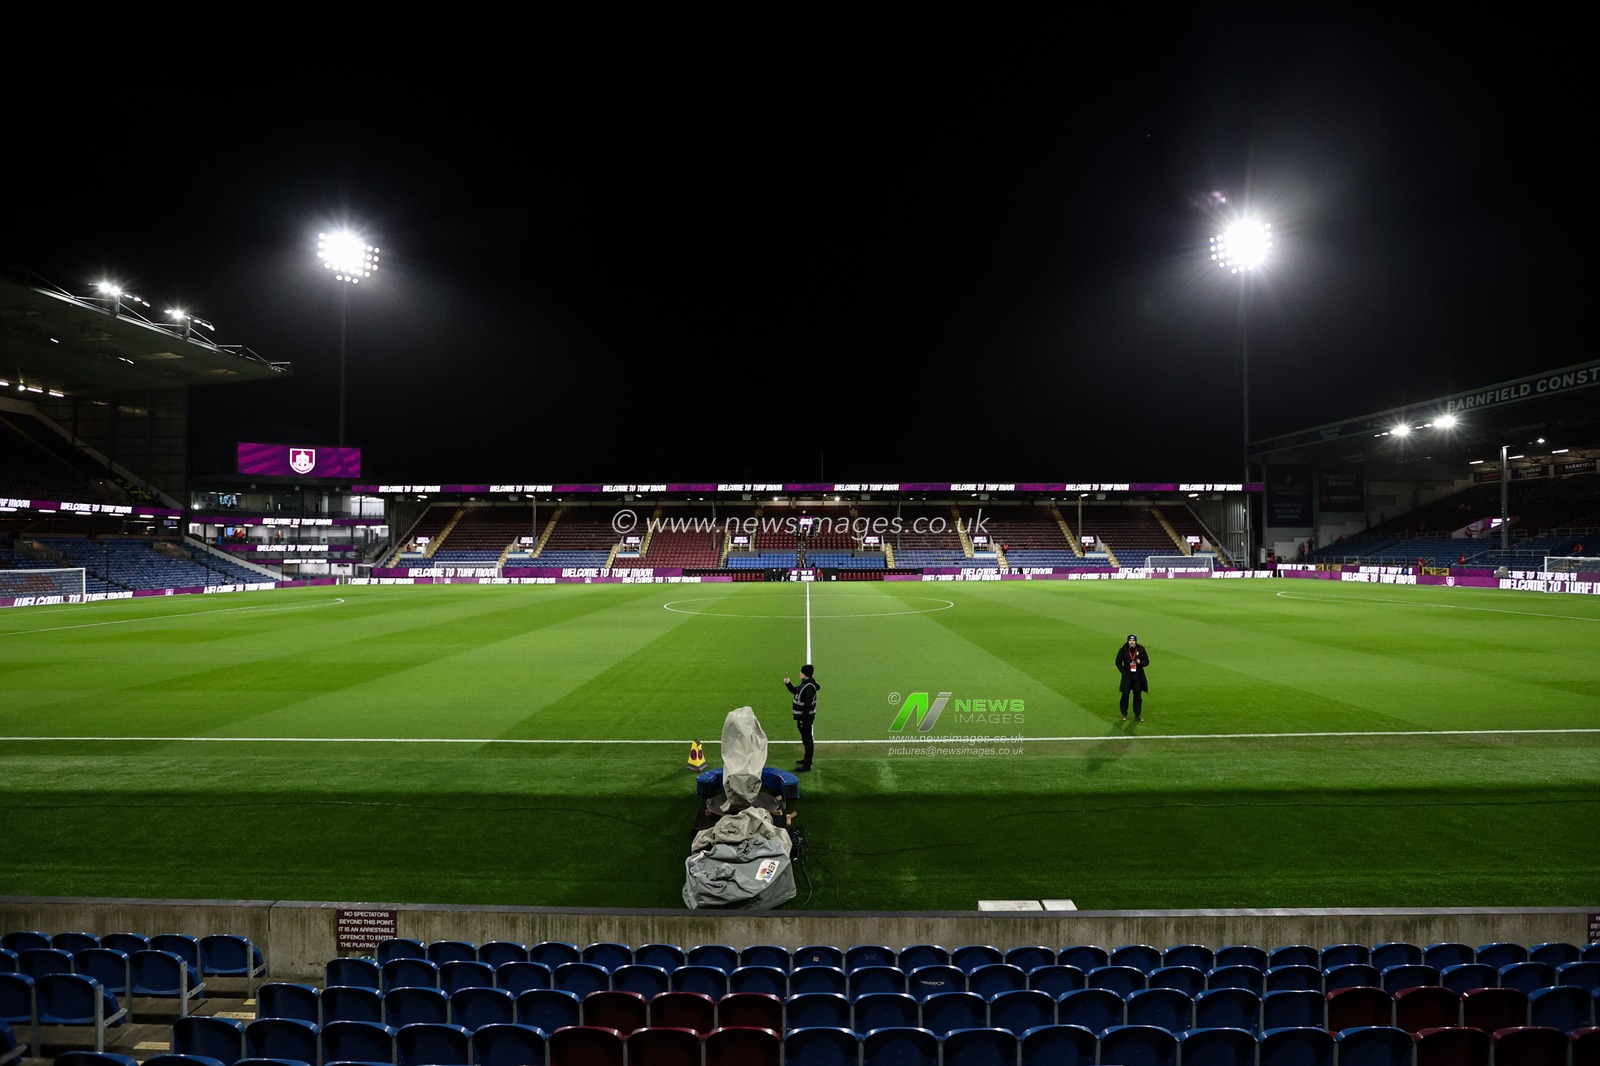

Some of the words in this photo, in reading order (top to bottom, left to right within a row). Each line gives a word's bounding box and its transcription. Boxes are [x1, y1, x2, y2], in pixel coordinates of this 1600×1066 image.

[1448, 384, 1530, 411] BARNFIELD
[1537, 369, 1600, 392] CONST
[562, 568, 598, 577] WELCOME
[600, 568, 609, 577] TO
[612, 568, 630, 577] TURF
[630, 568, 653, 577] MOOR
[1500, 578, 1545, 592] WELCOME
[1549, 581, 1561, 592] TO
[1565, 582, 1592, 593] TURF
